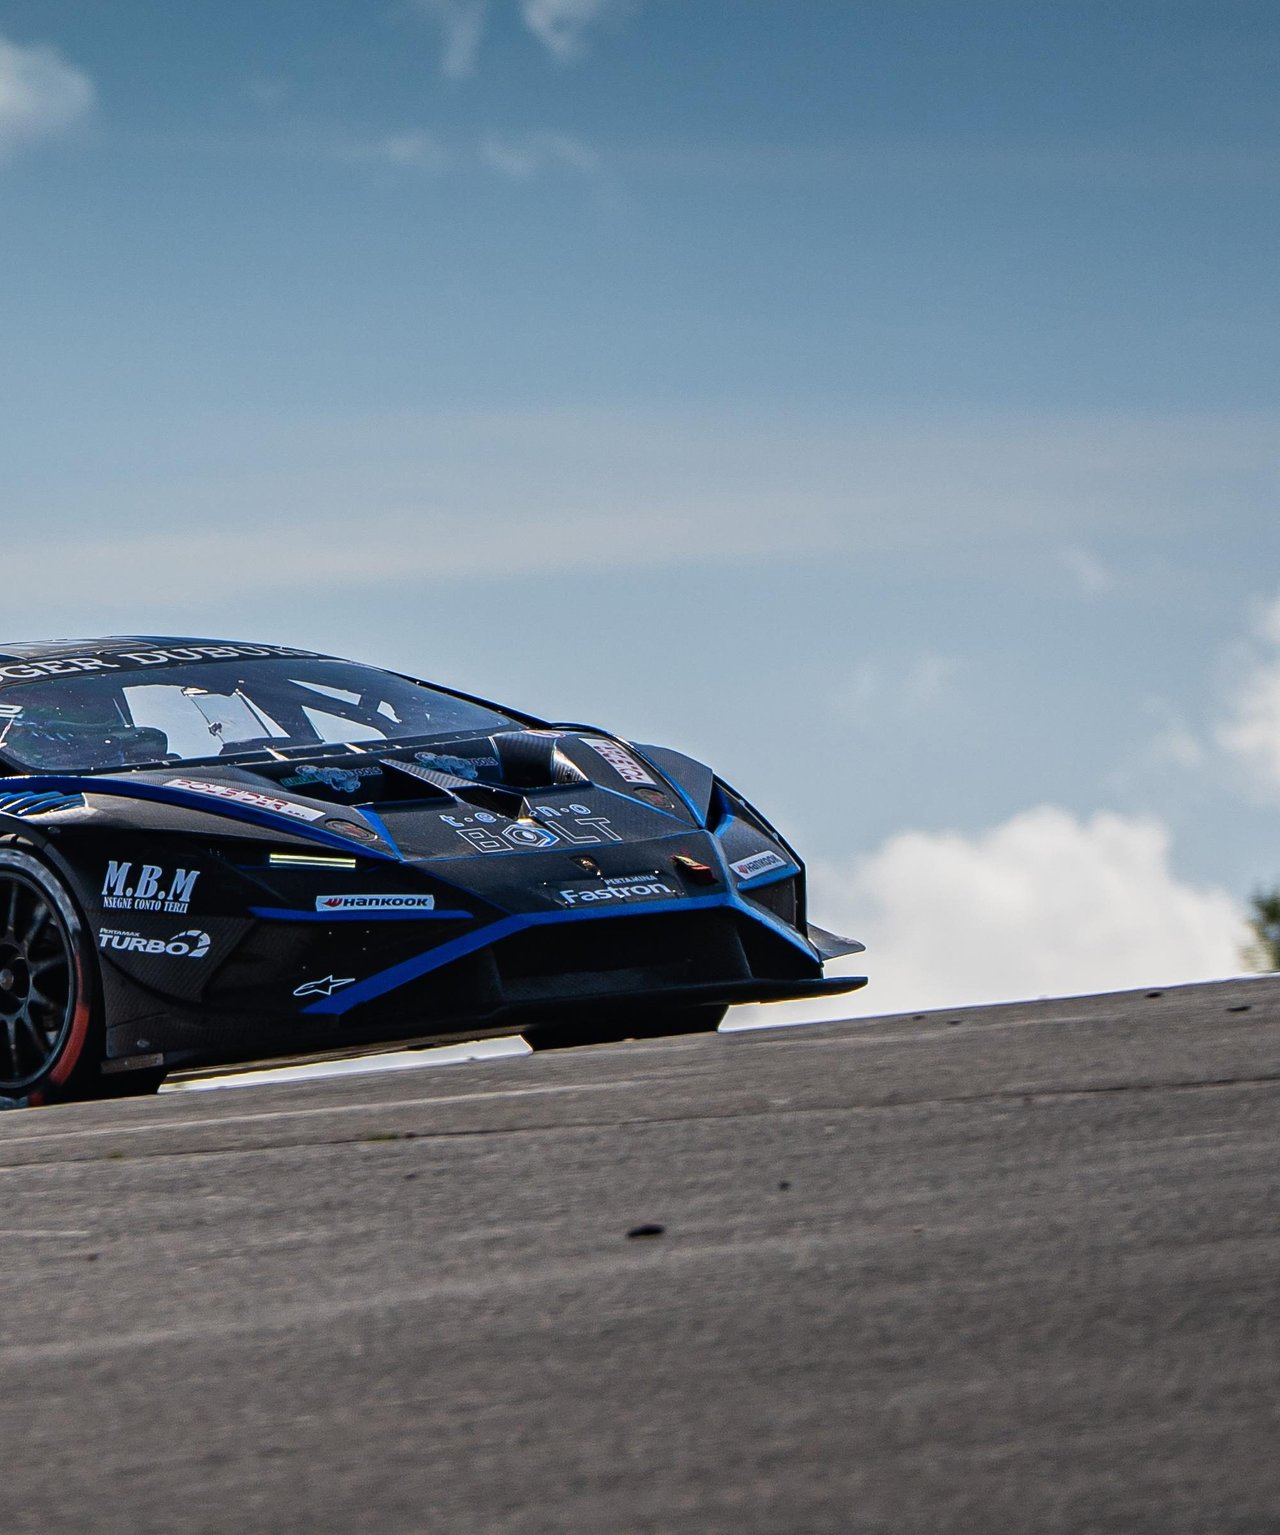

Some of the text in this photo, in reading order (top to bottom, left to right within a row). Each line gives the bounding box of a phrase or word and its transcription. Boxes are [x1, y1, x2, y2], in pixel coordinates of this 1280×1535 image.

[455, 816, 624, 854] BOLT
[101, 860, 201, 903] M.B.M
[603, 873, 658, 886] PERTAMINA
[559, 881, 671, 904] Fastron
[134, 898, 163, 912] CONTO
[164, 900, 189, 914] TERZI
